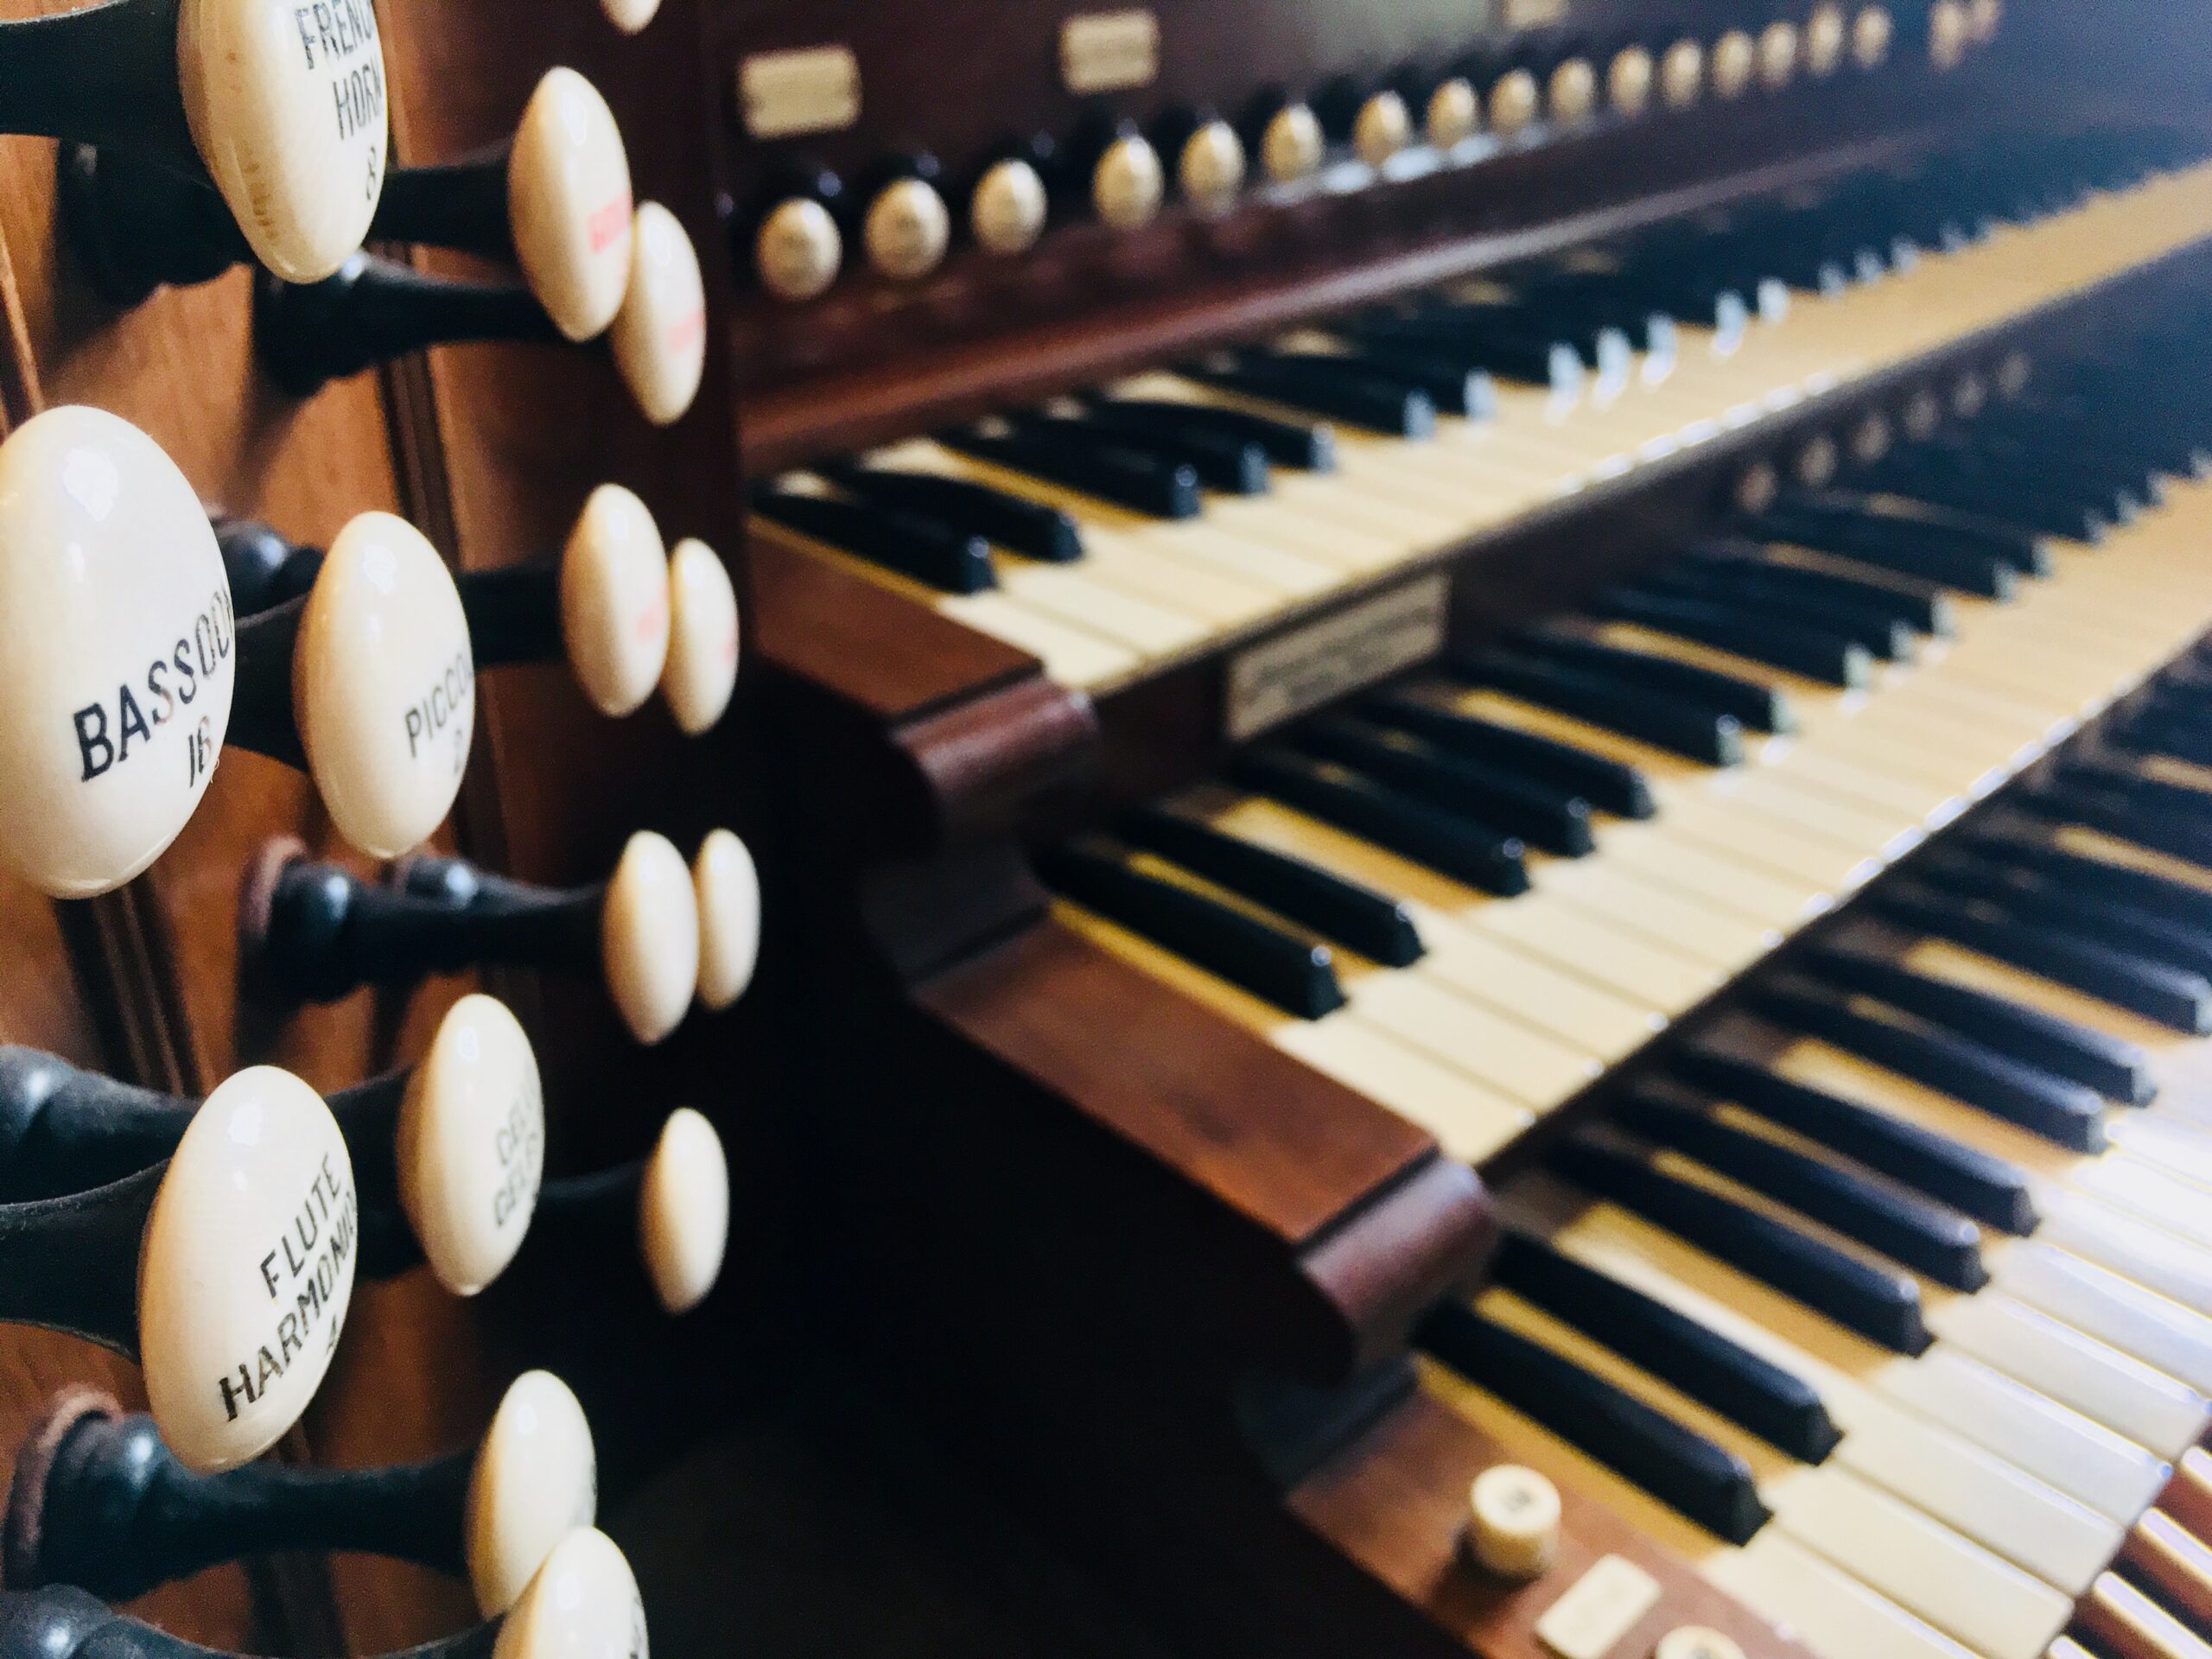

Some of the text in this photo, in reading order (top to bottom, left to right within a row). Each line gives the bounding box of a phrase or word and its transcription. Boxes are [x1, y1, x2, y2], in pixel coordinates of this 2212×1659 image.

[334, 55, 383, 140] HORN
[189, 715, 213, 788] 16
[260, 1151, 340, 1299] FLUTE
